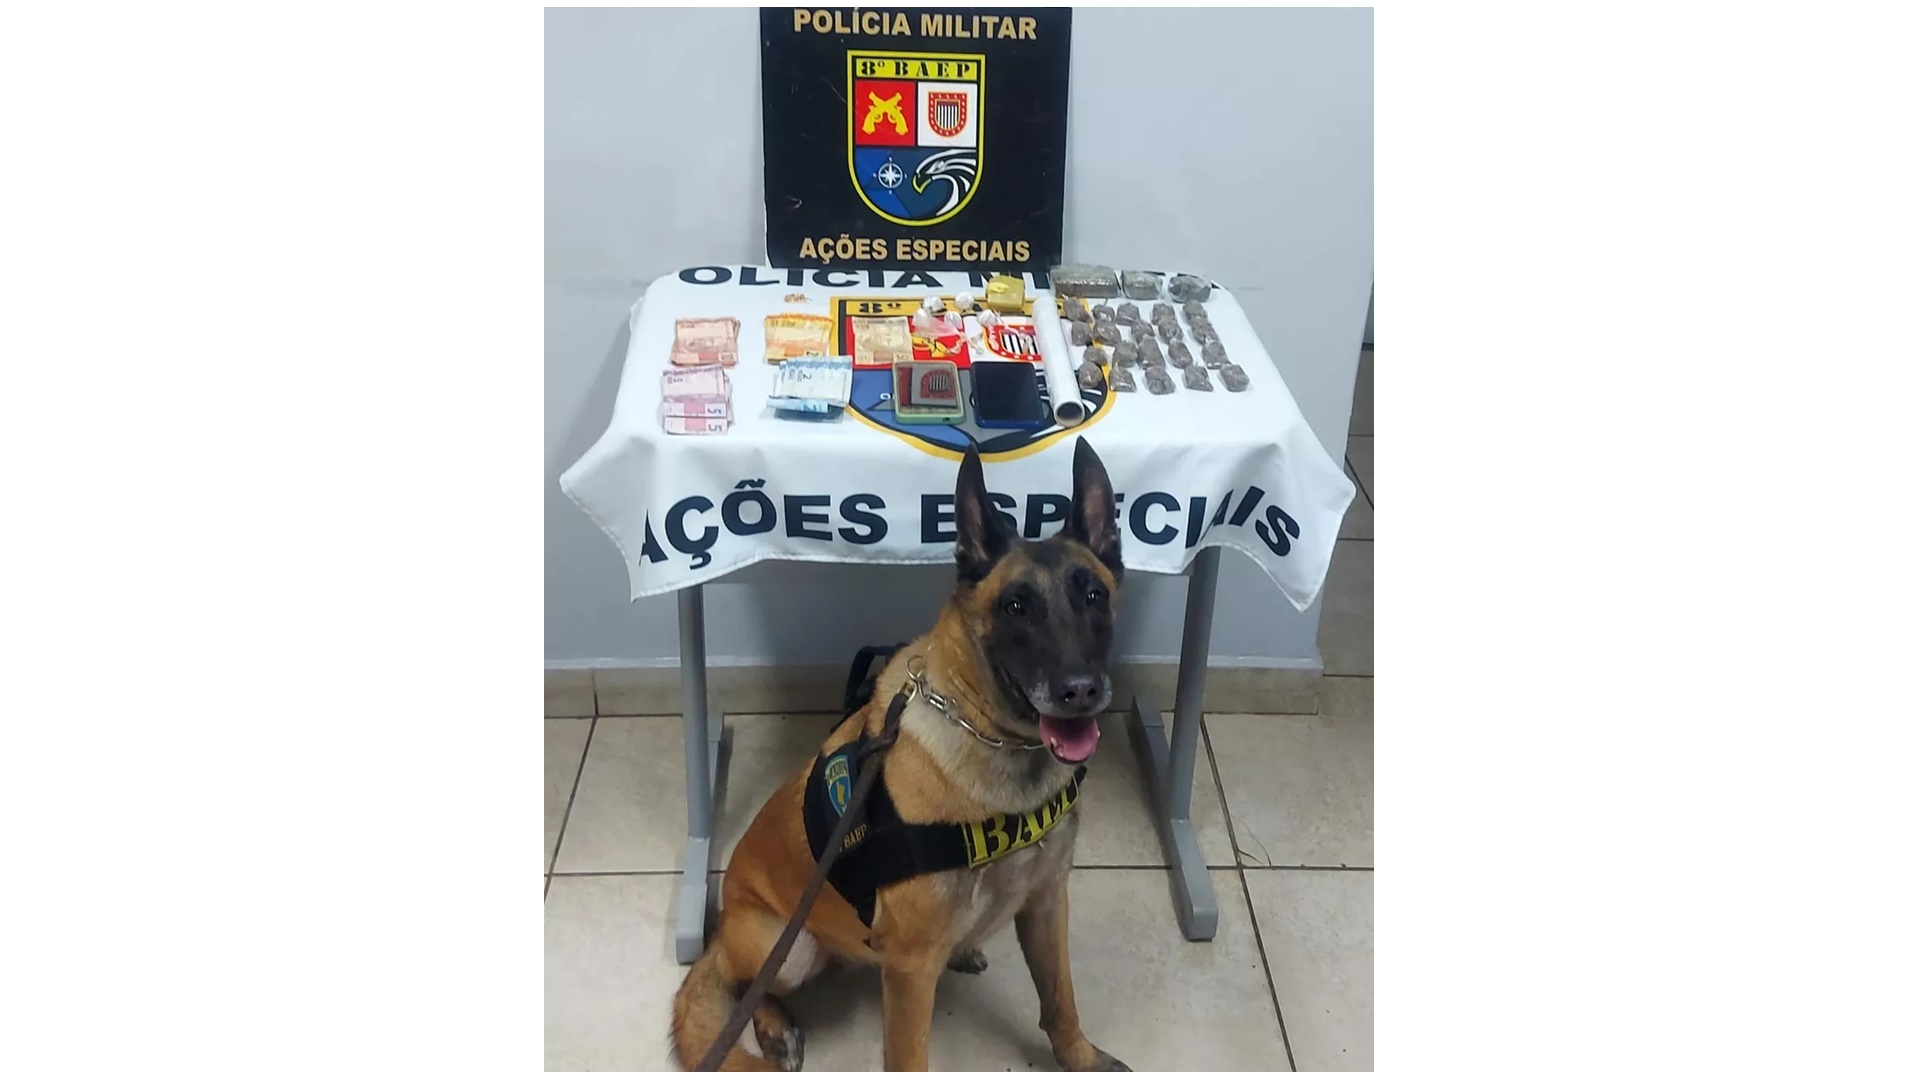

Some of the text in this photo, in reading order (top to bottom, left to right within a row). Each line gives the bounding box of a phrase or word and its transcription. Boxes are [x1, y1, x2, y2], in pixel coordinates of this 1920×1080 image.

[793, 7, 1038, 40] POLÍCIA MILITAR
[894, 61, 971, 78] BAEP
[799, 233, 1030, 265] AÇÕES ESPECIAIS
